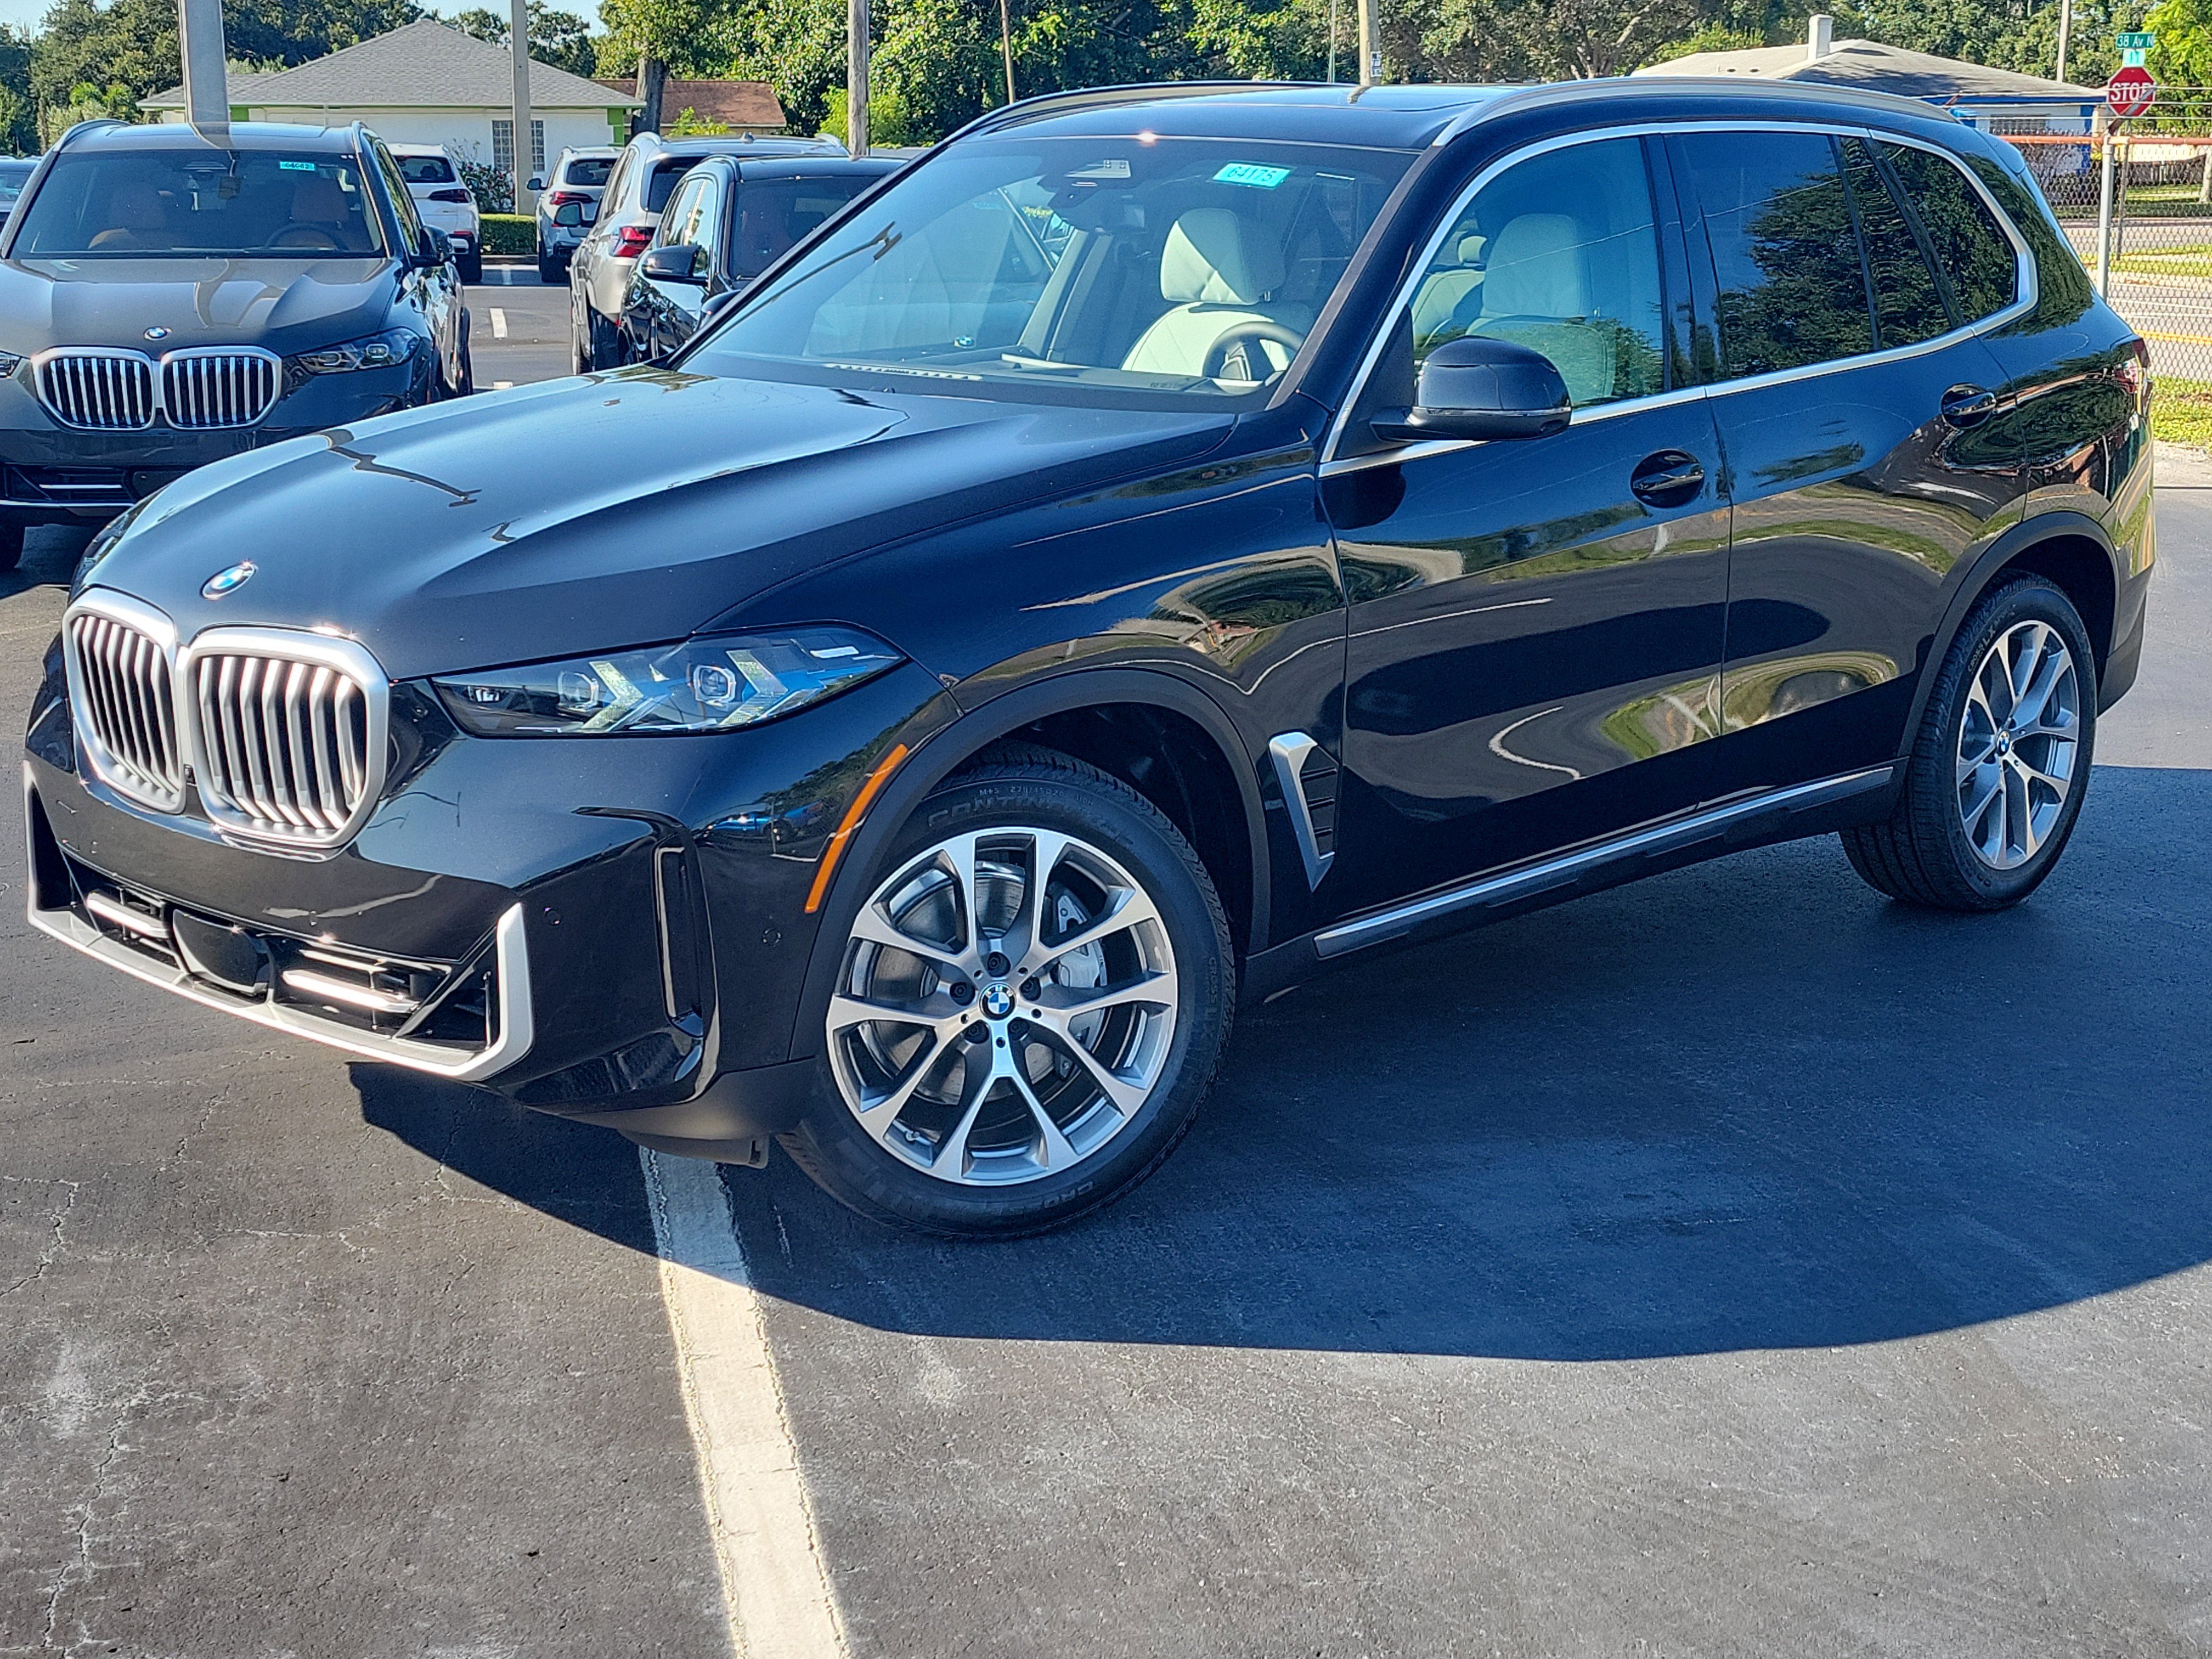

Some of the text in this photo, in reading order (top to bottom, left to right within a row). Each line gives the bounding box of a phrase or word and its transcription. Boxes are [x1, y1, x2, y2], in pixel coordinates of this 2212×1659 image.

[2117, 35, 2153, 47] 38 Av N
[2111, 82, 2152, 101] STOP
[1228, 166, 1277, 182] 64175
